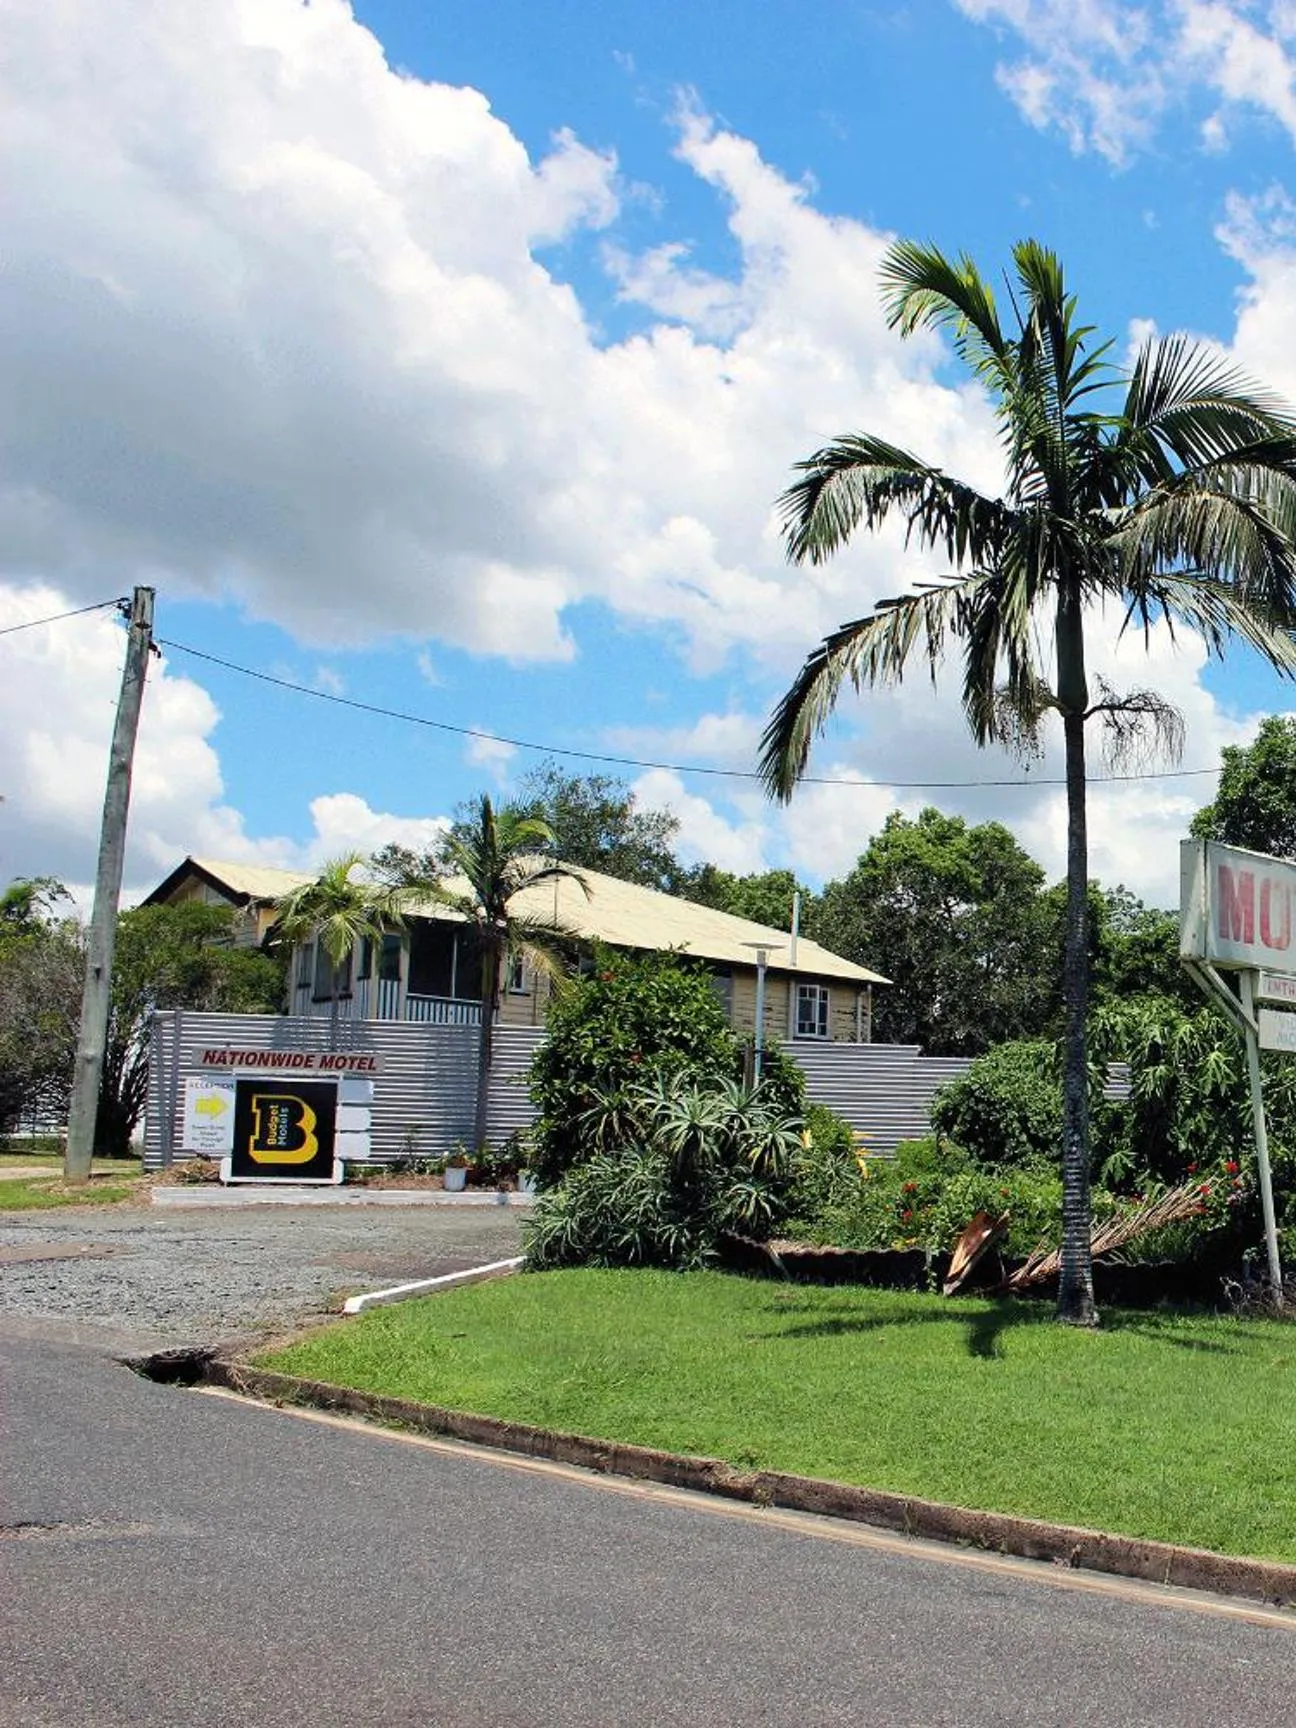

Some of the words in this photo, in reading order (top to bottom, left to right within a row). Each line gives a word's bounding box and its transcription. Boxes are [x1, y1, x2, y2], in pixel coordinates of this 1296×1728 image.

[202, 1049, 315, 1069] NATIONWIDE
[318, 1055, 377, 1071] MOTEL
[267, 1104, 279, 1145] Budget
